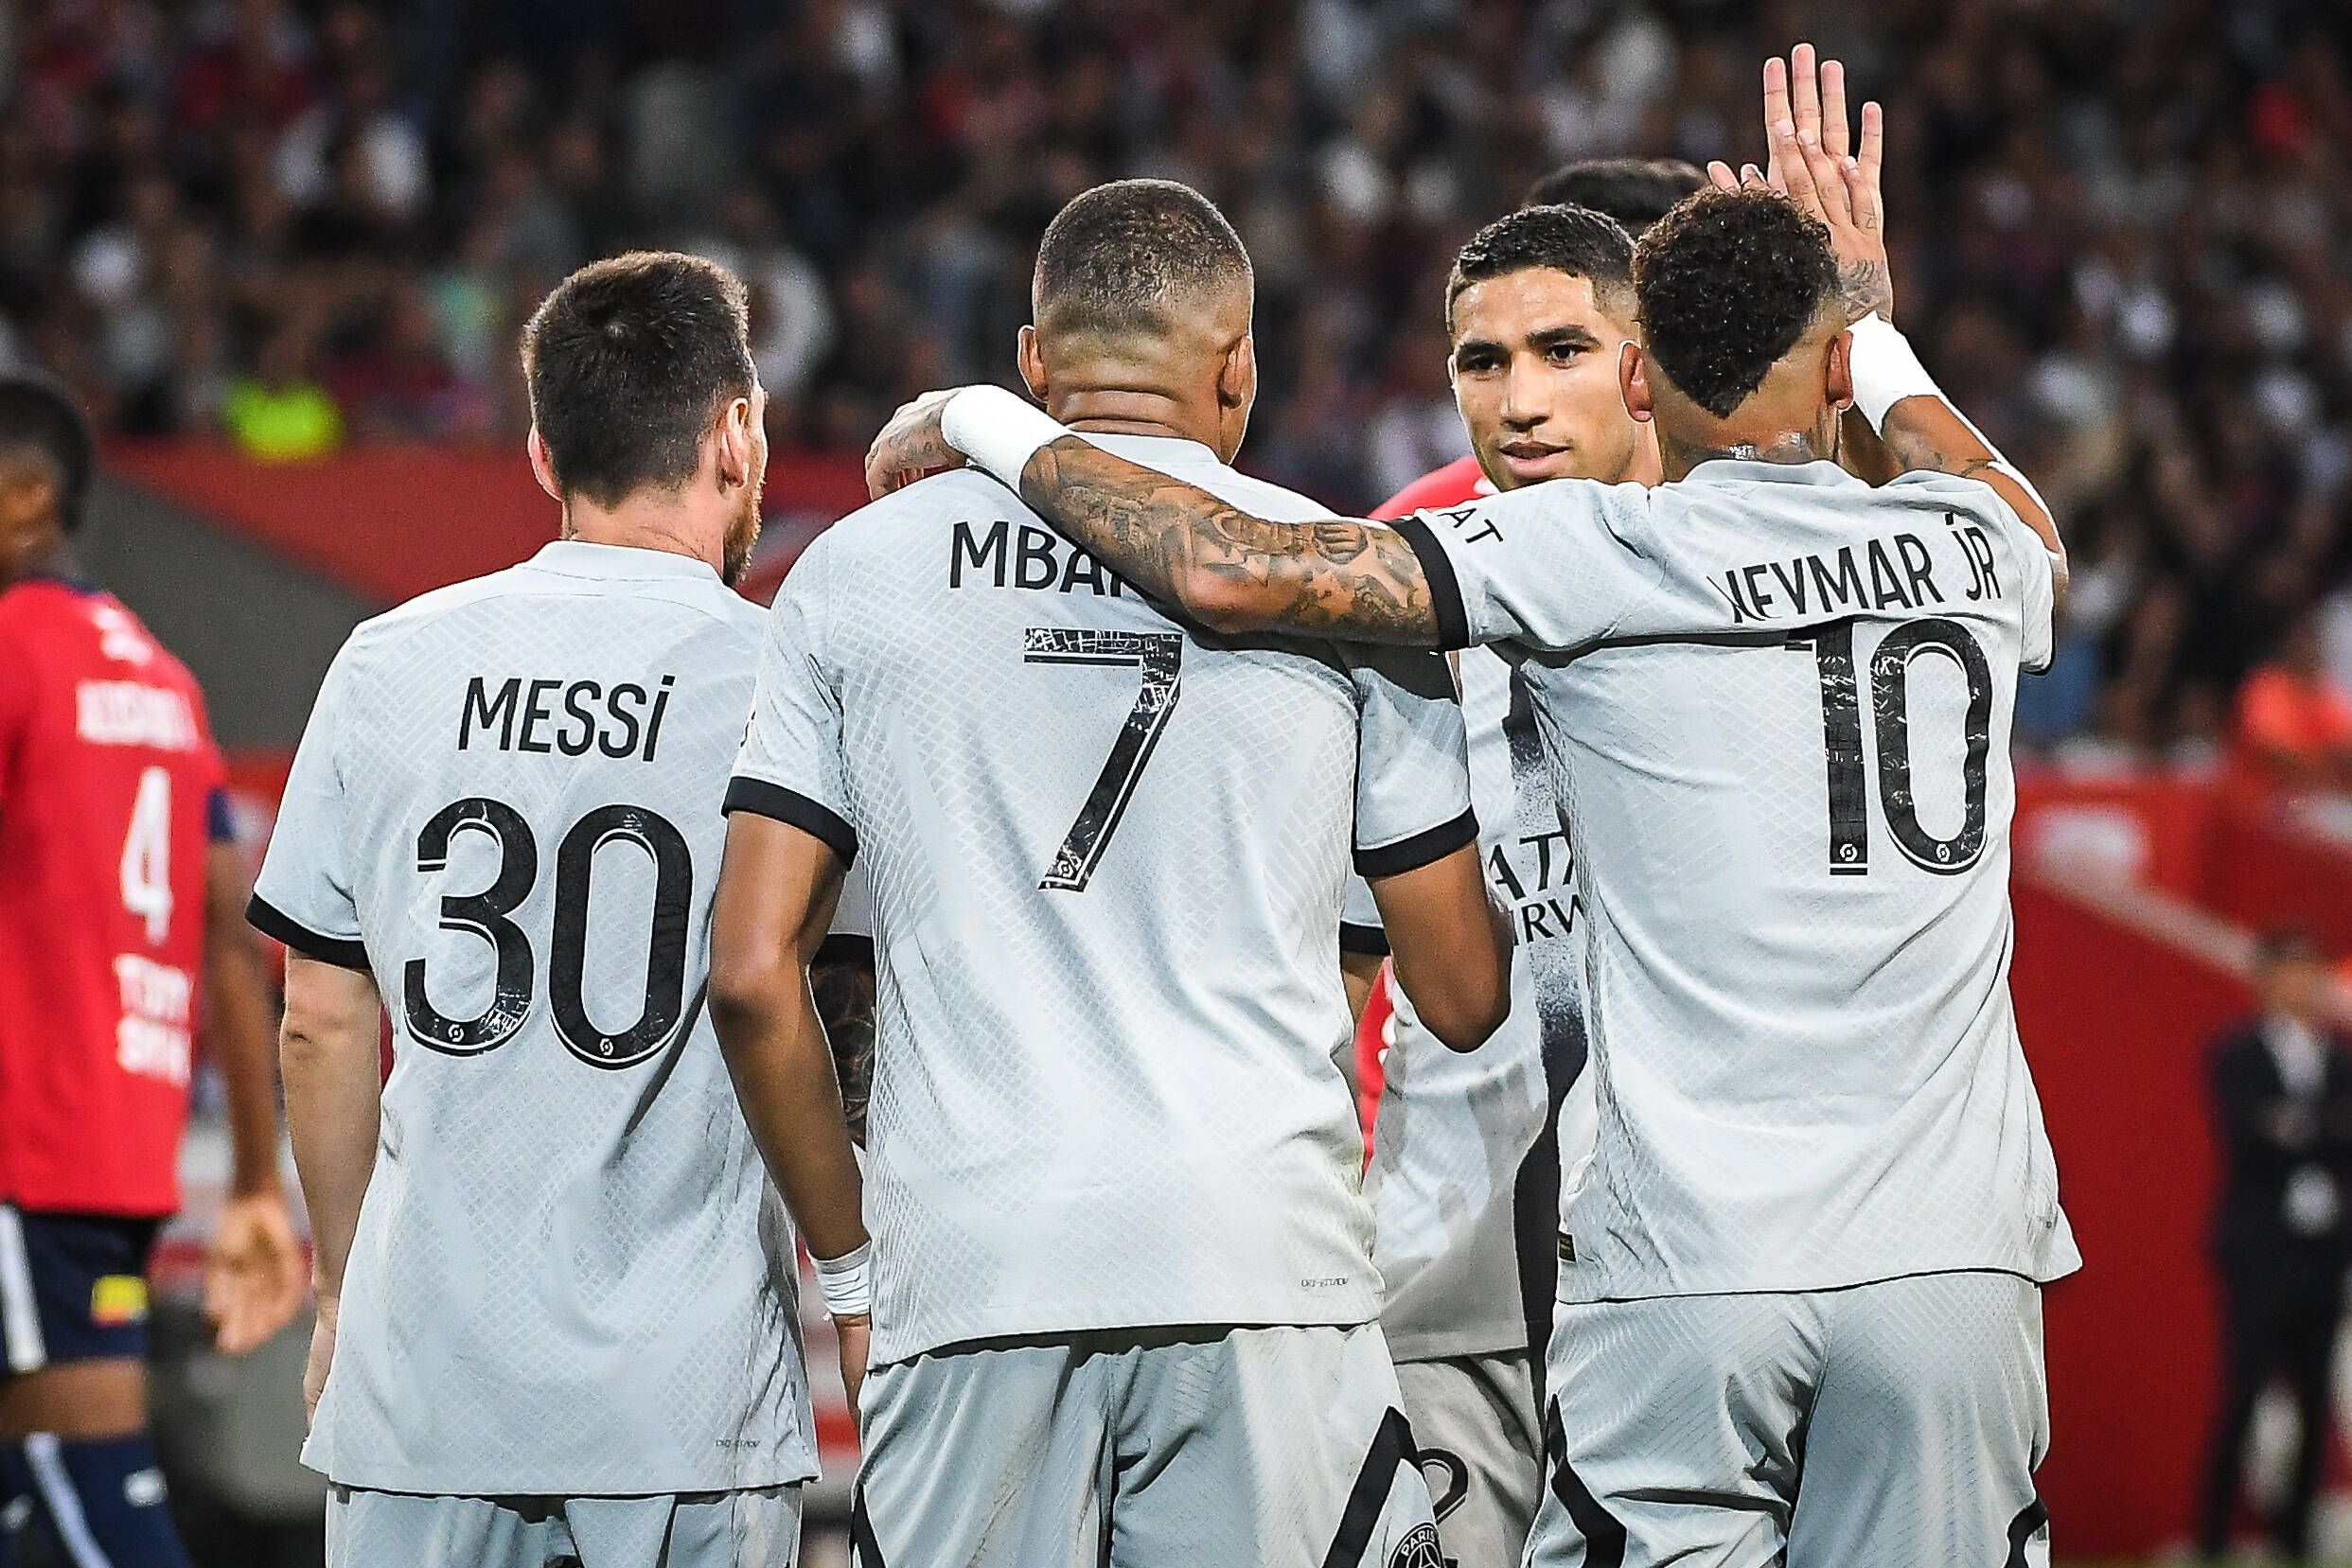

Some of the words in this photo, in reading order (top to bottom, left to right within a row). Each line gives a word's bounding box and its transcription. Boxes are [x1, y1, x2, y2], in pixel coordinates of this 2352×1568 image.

[949, 520, 1123, 598] MBA
[1707, 533, 1946, 624] NEYMAR
[1024, 627, 1183, 893] 7
[1785, 616, 1993, 875] 10
[120, 766, 173, 944] 4
[404, 797, 694, 1071] 30
[1400, 1528, 1437, 1558] PARIS
